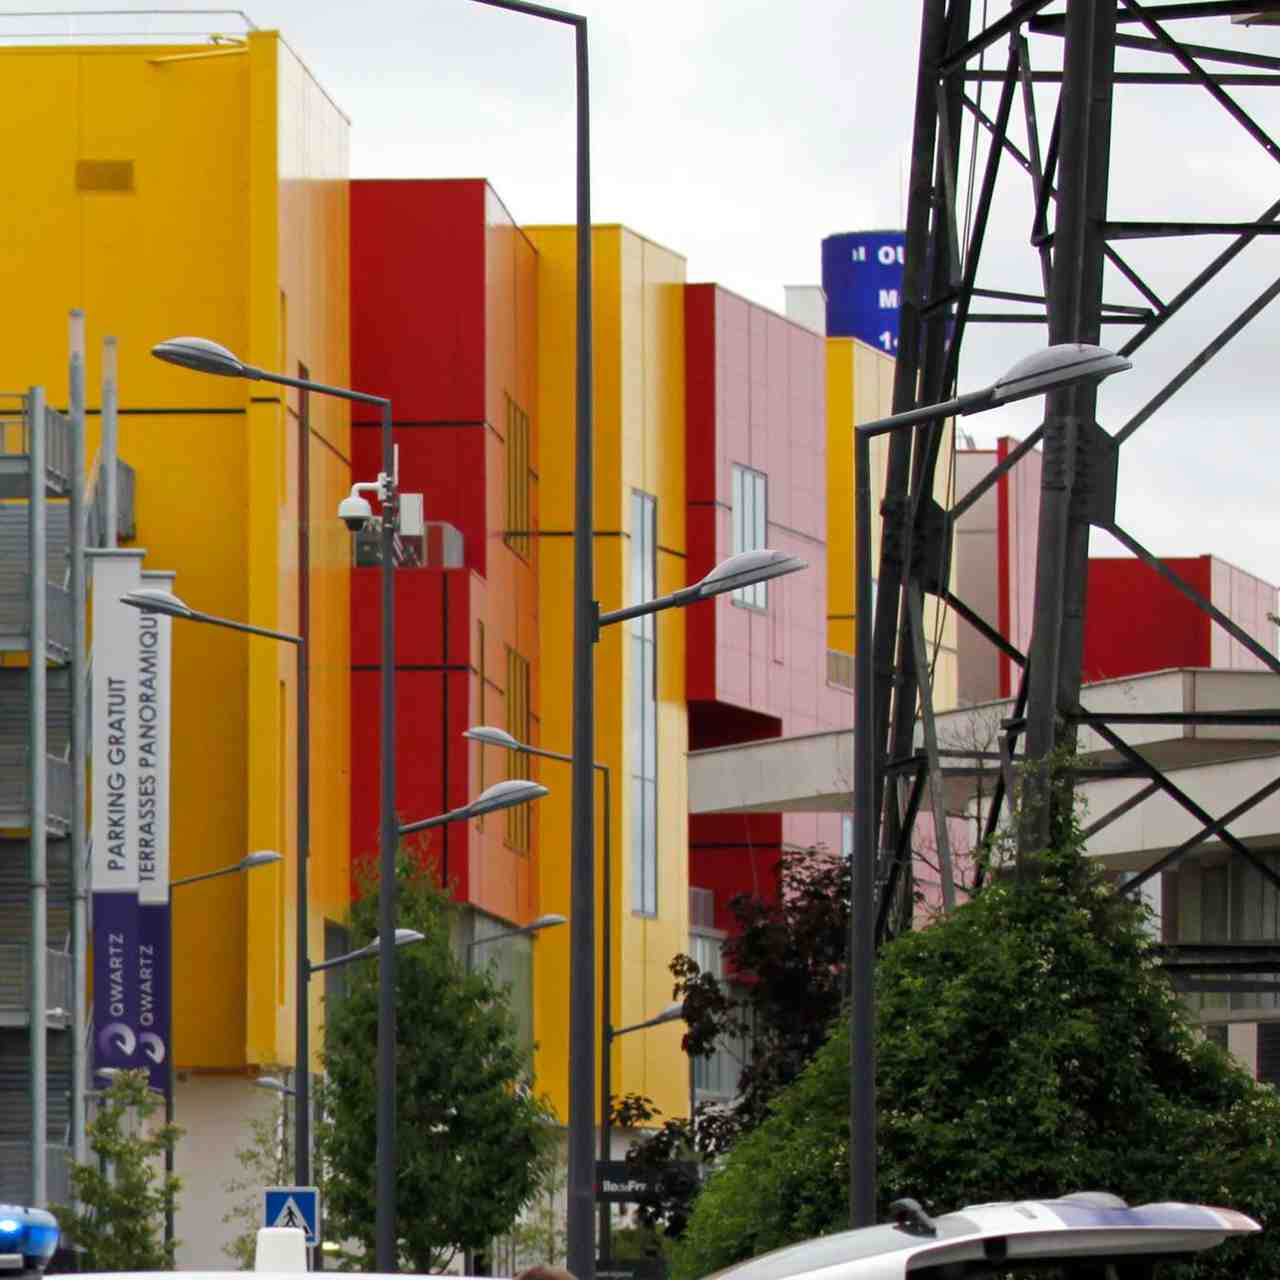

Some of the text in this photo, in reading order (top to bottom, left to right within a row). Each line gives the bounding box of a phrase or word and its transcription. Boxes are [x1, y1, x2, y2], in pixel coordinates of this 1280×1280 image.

[107, 676, 127, 872] PARKING GRATUIT
[138, 603, 159, 883] TERRASSES PANORAMIQU
[108, 932, 125, 1017] QWARTZ
[139, 944, 155, 1026] QWARTZ
